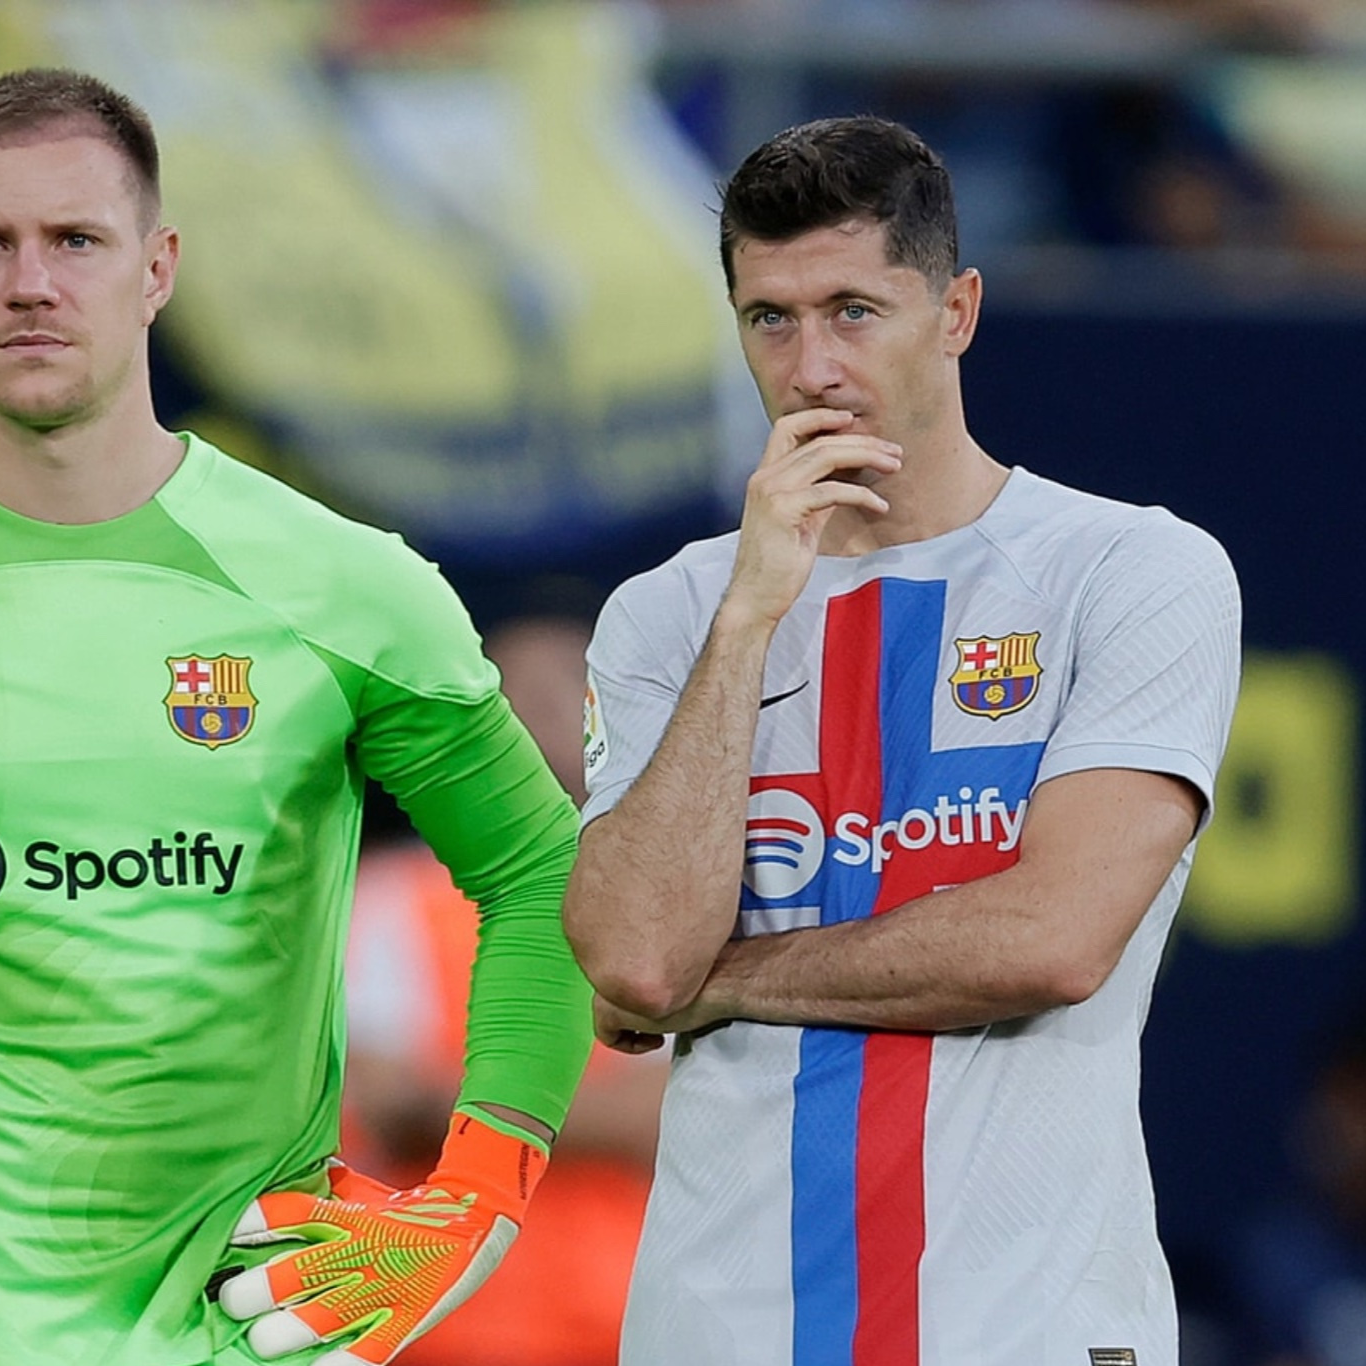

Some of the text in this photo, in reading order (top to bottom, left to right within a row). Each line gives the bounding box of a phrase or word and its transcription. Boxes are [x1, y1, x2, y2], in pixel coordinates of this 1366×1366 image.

[193, 693, 228, 705] FCB
[23, 830, 245, 901] Spotify
[832, 786, 1029, 874] Spotify
